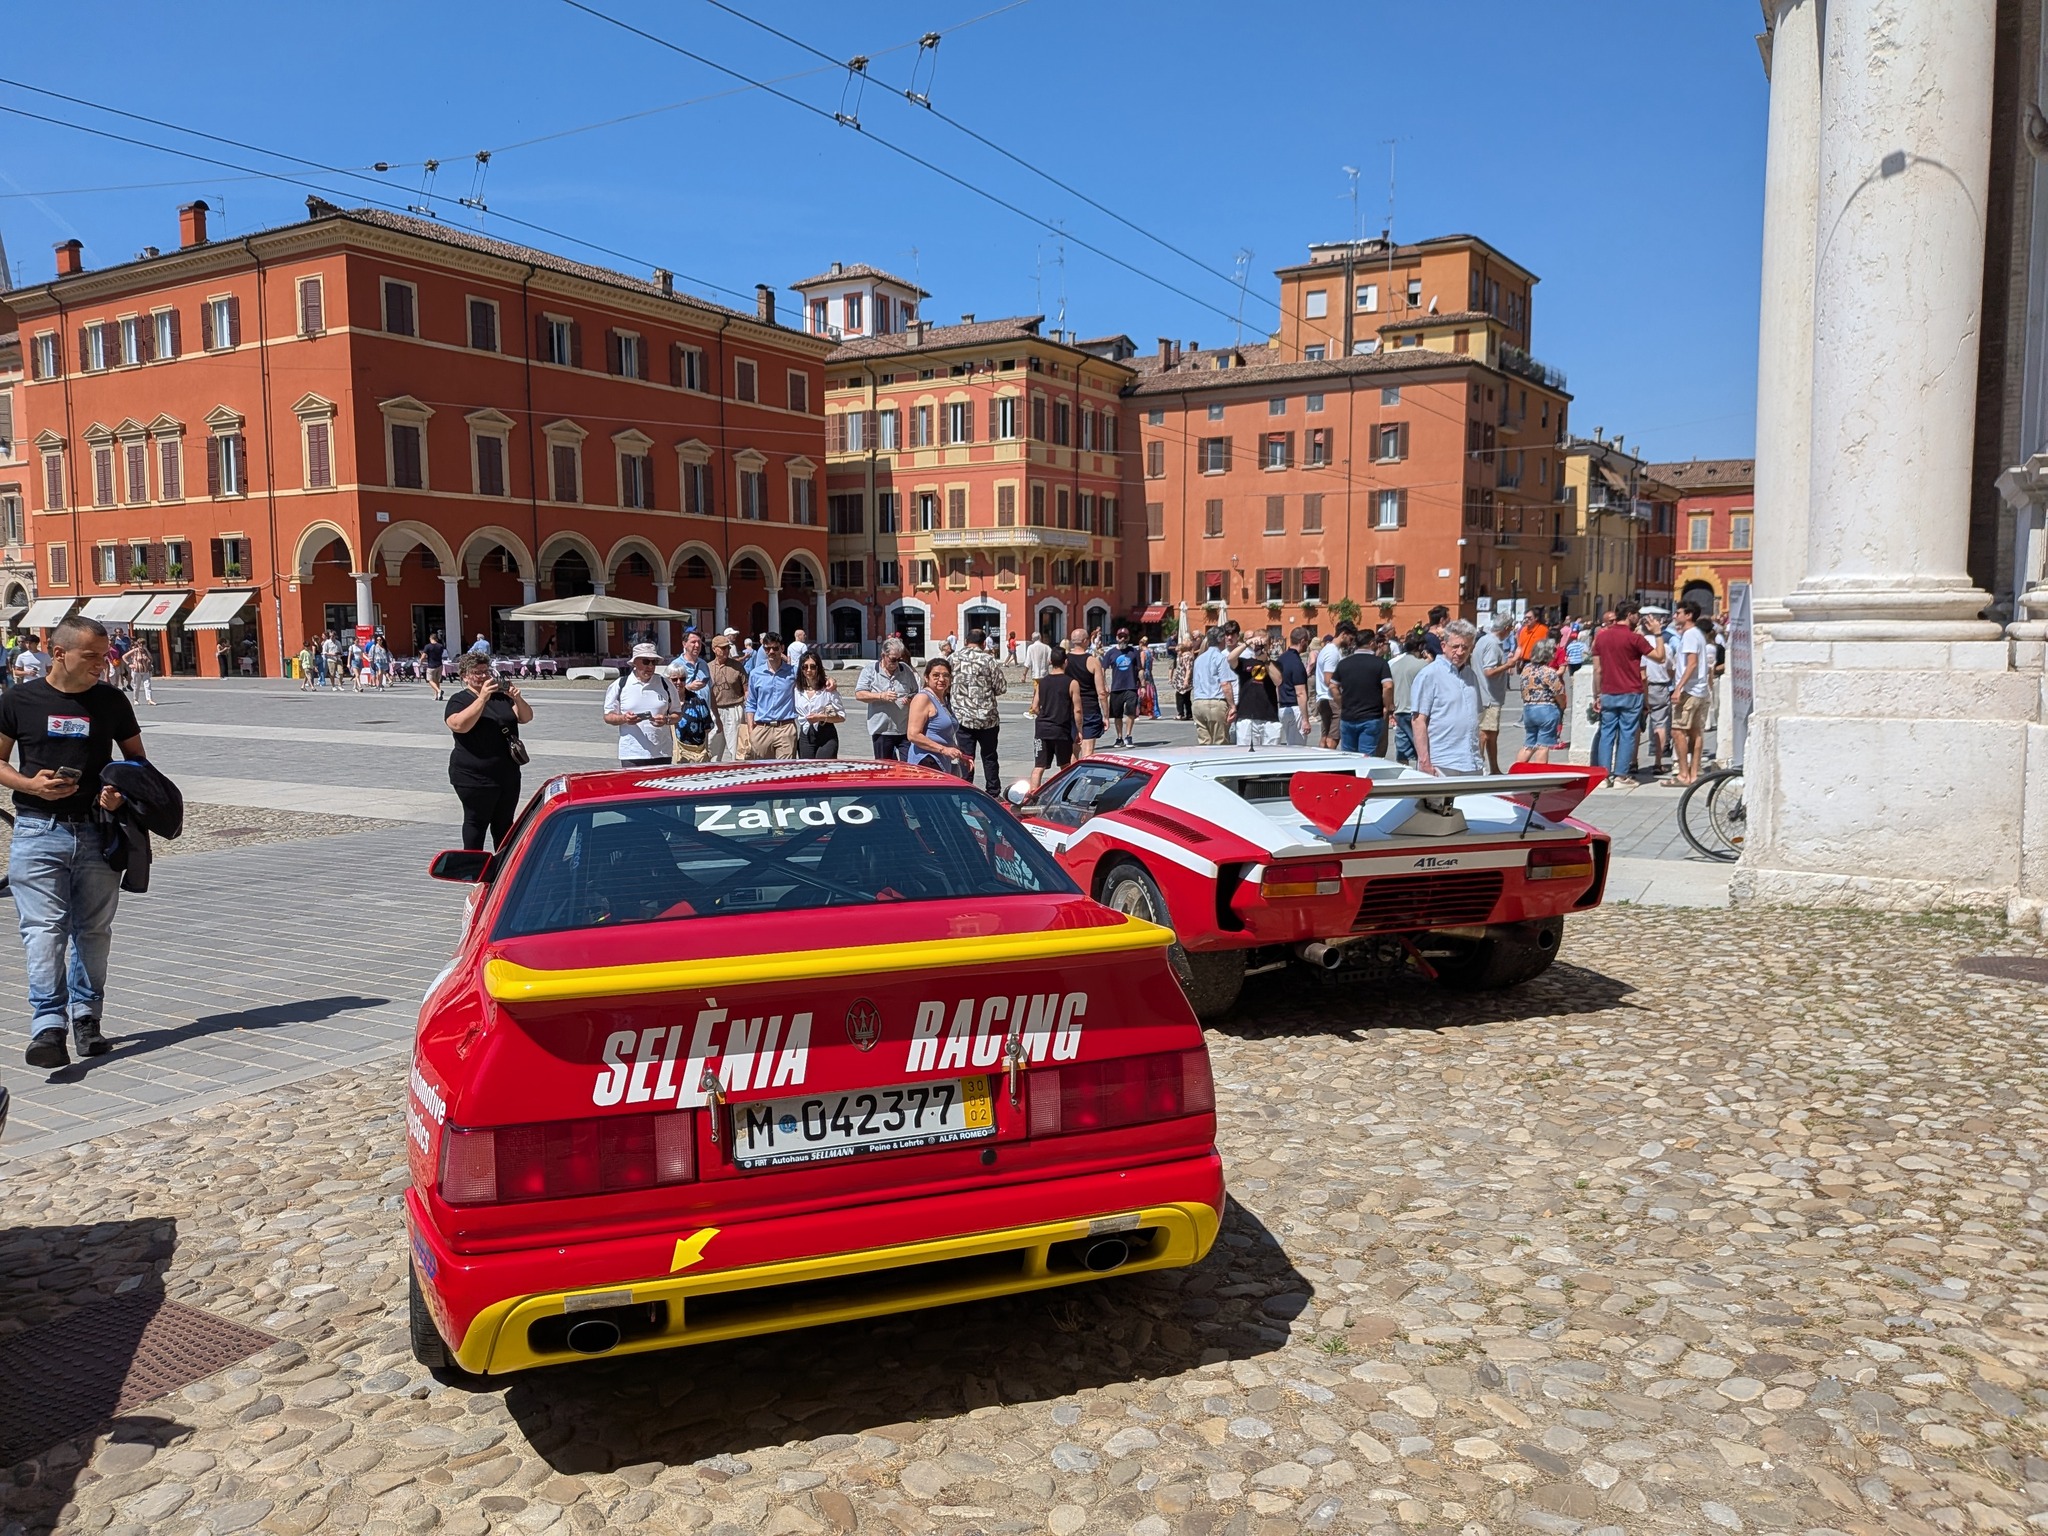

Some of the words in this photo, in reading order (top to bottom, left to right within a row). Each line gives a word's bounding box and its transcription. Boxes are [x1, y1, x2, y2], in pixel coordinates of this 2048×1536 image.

[694, 800, 874, 832] Zardo
[592, 997, 814, 1109] SELÈNIA
[905, 992, 1088, 1073] RACING
[967, 1080, 984, 1092] 30
[969, 1094, 986, 1107] 09
[746, 1106, 775, 1149] M
[801, 1084, 955, 1142] 042377
[970, 1109, 987, 1121] 02
[754, 1158, 768, 1167] FIAT
[771, 1154, 809, 1166] Autohaus
[810, 1147, 855, 1161] SELLMANN
[869, 1143, 892, 1153] Peine
[892, 1142, 899, 1150] &
[899, 1139, 925, 1149] Lehrte
[939, 1135, 959, 1143] ALFA
[959, 1129, 988, 1140] ROMEO
